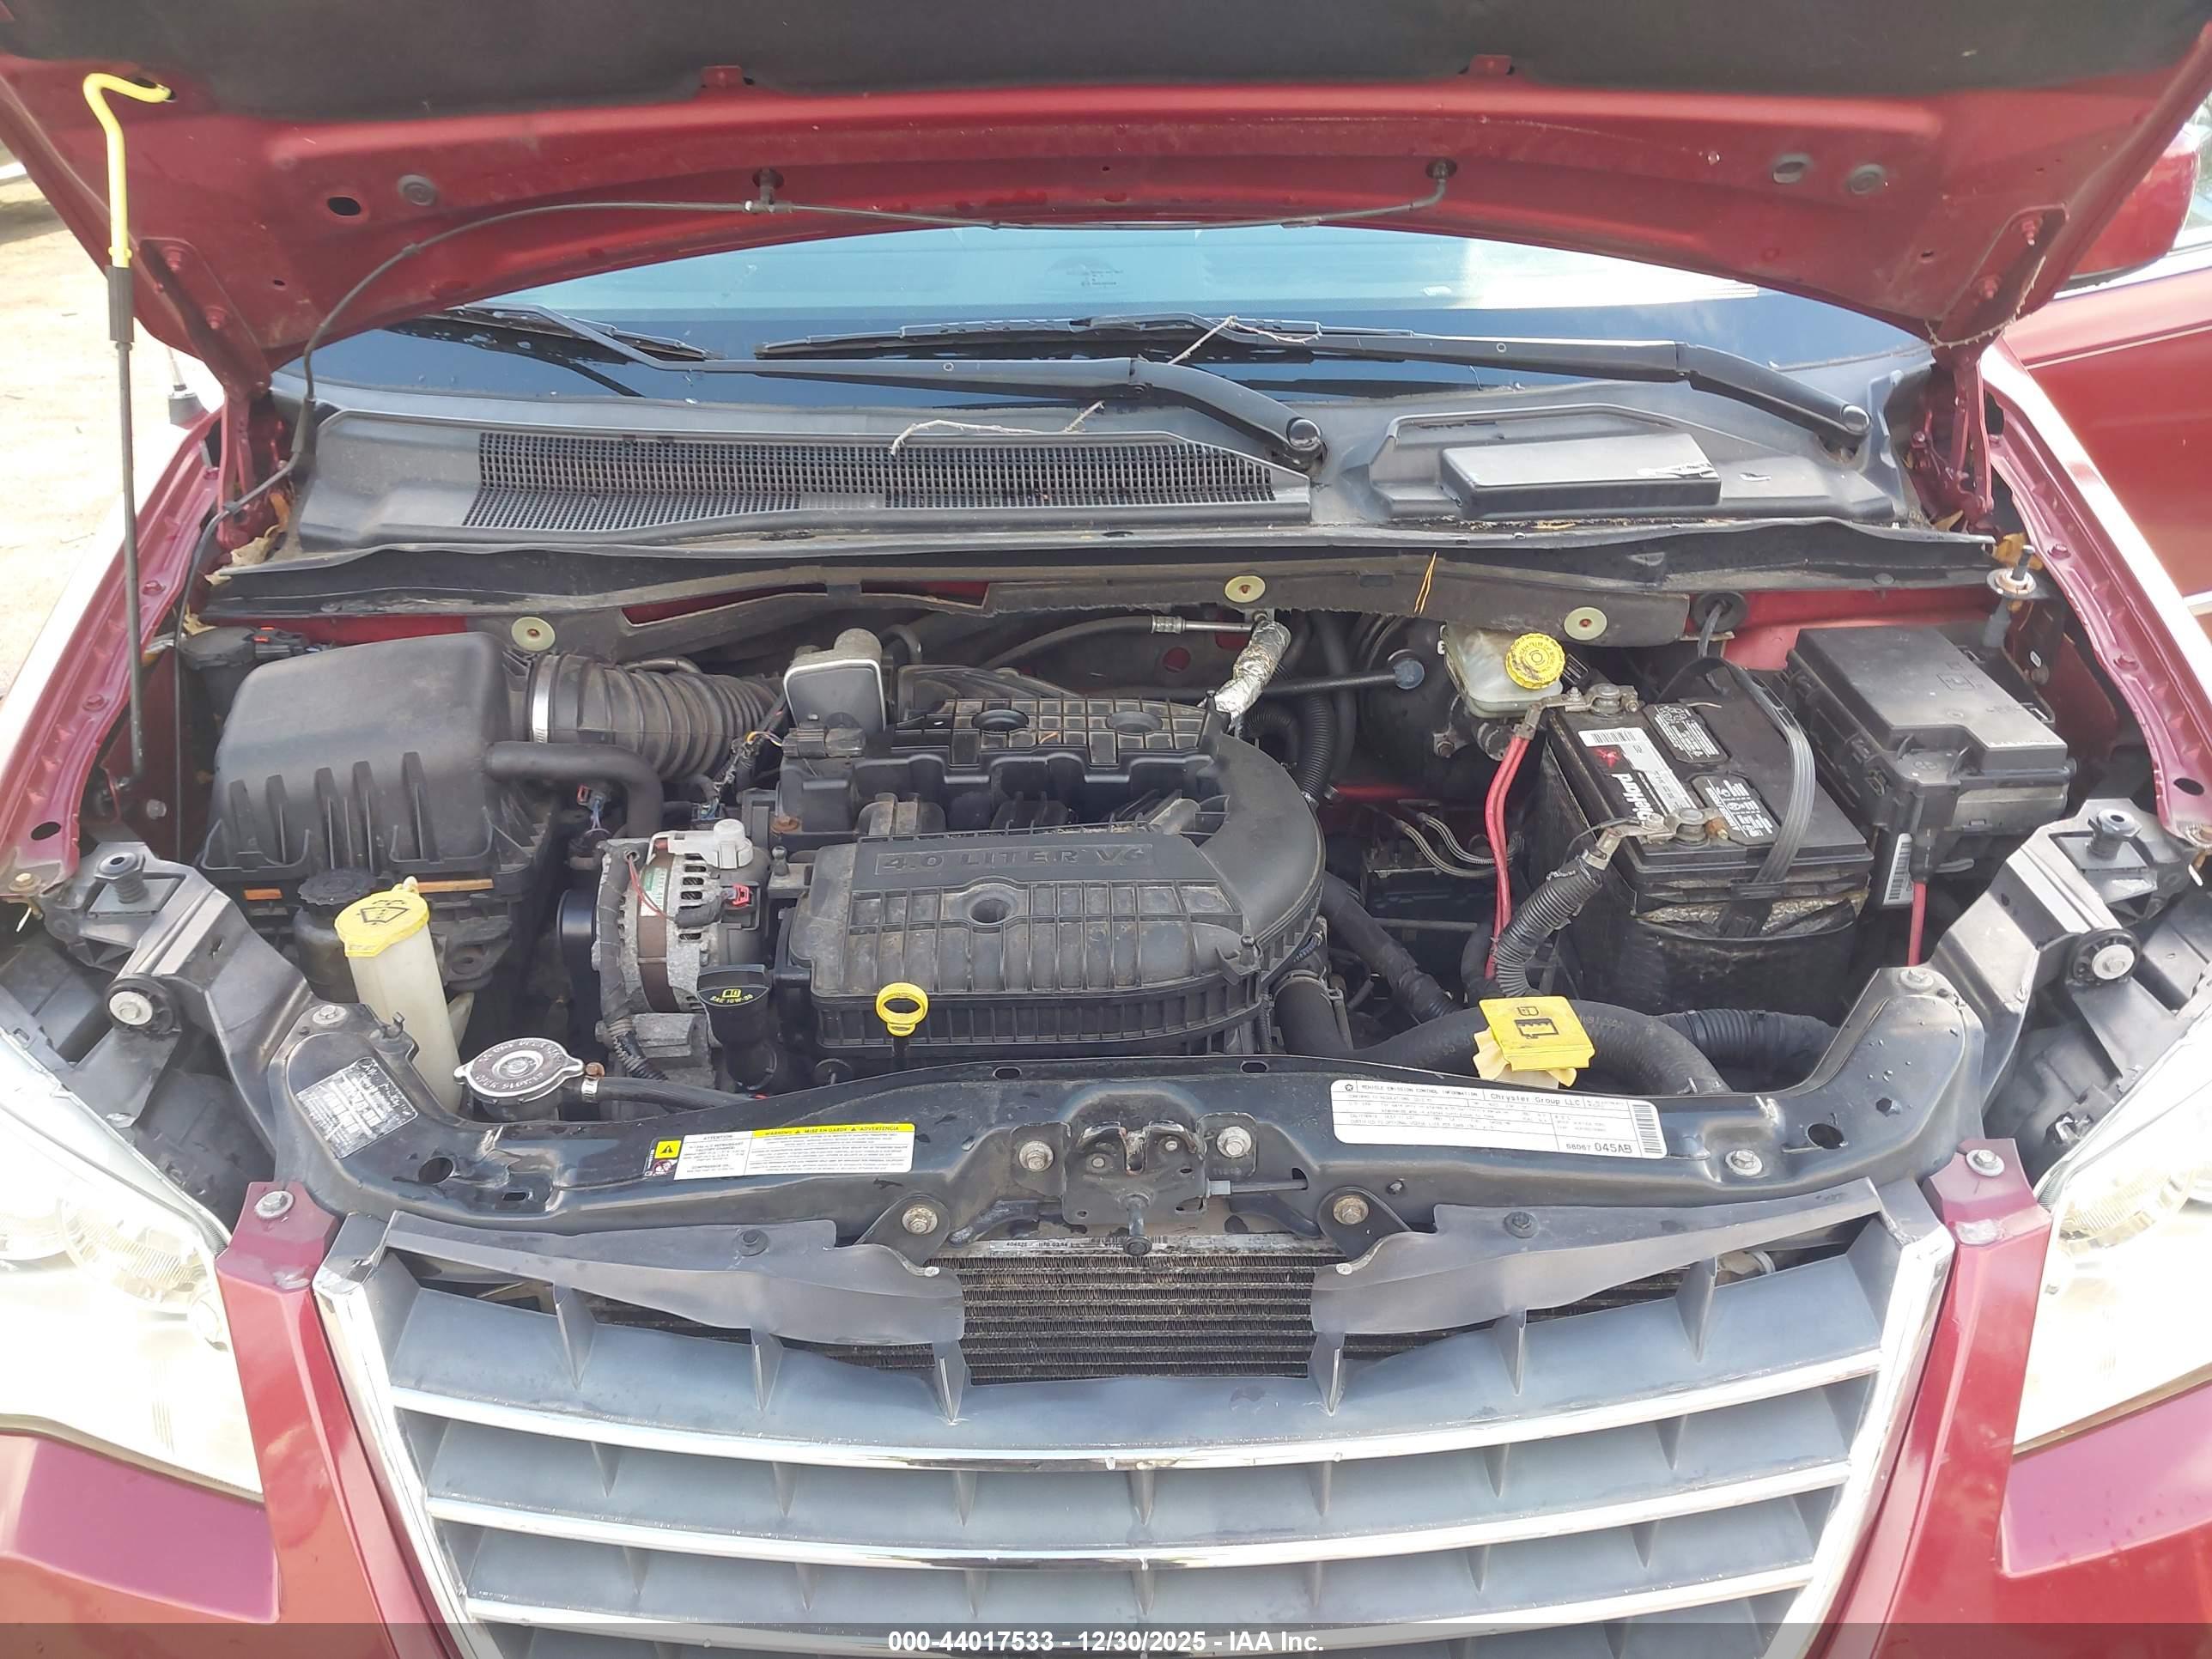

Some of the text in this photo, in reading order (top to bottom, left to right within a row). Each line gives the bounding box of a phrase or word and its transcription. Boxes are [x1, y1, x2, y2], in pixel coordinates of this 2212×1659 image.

[883, 847, 1146, 870] 4.0 LITER V6
[1490, 1092, 1529, 1103] Chrysler
[1535, 1097, 1560, 1105] Group
[1594, 1142, 1633, 1154] 045AB
